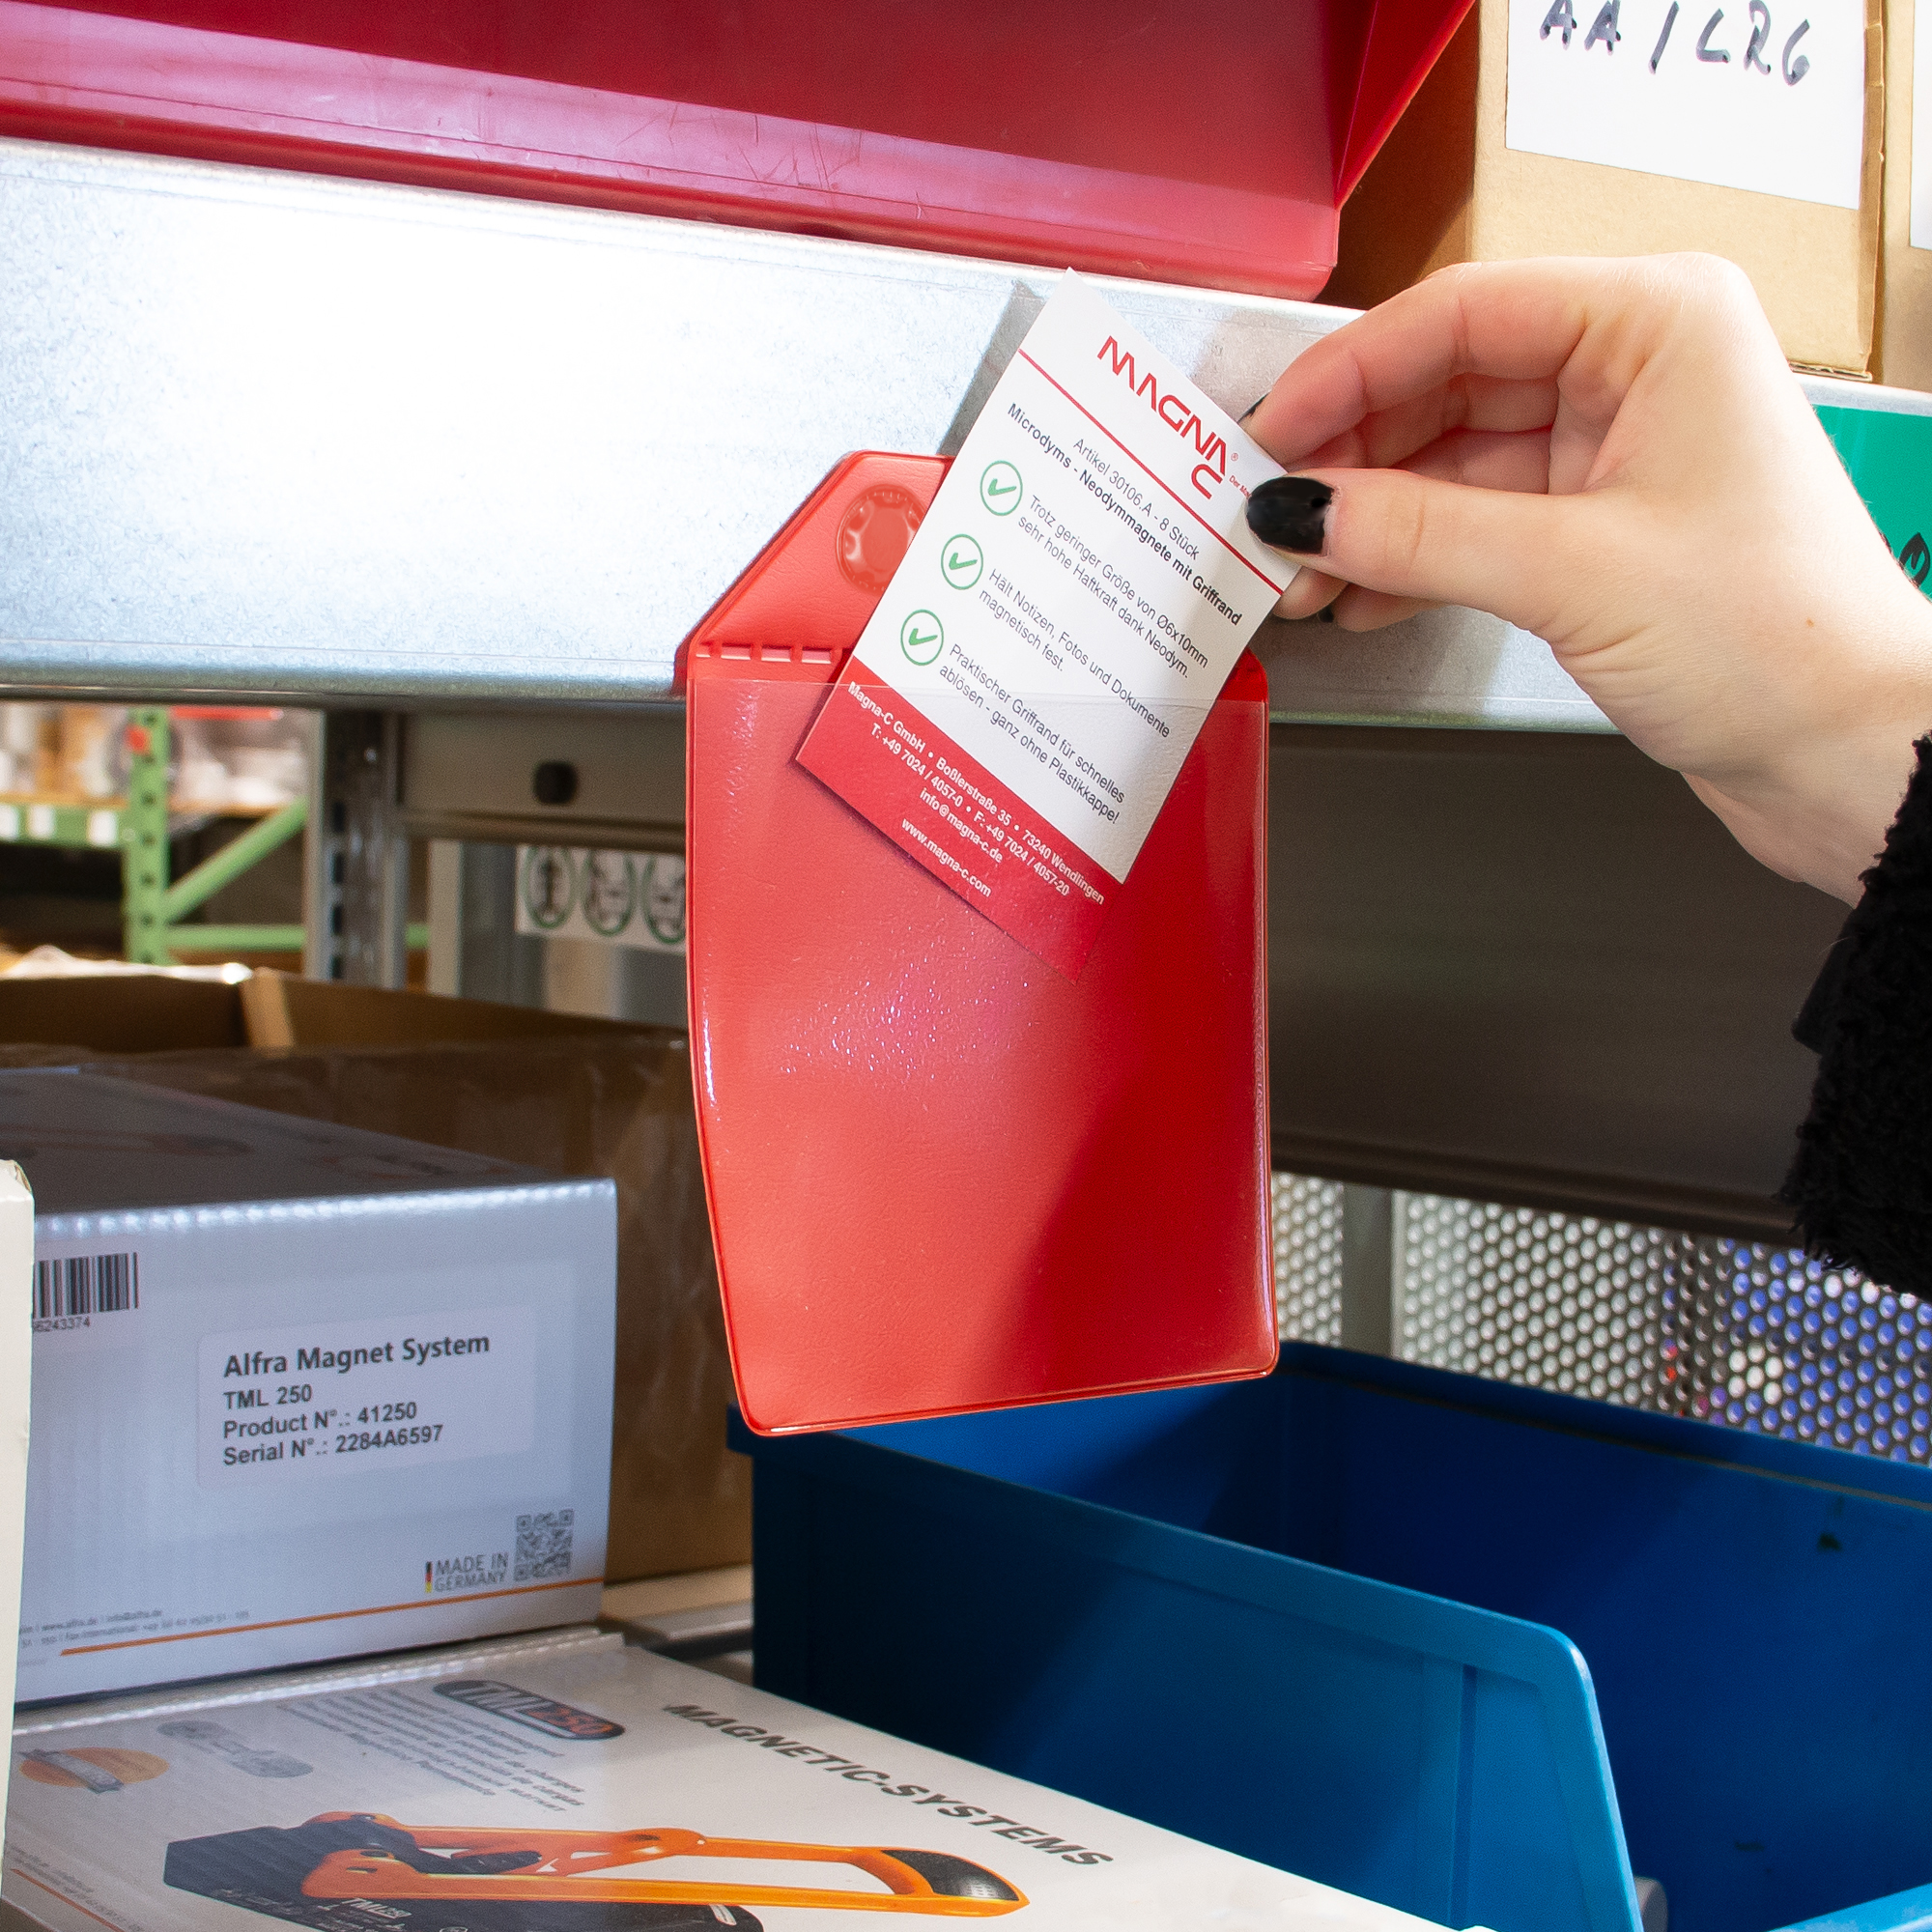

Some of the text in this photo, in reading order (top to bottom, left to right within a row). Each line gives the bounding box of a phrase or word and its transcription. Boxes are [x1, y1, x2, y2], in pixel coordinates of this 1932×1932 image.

[1540, 0, 1621, 55] AA
[1008, 403, 1072, 469] Microdyms
[1079, 469, 1172, 562] Neodymmagnete
[1172, 558, 1193, 582] mit
[1192, 575, 1243, 626] Griffrand
[1072, 439, 1111, 476] Artikel
[1108, 470, 1152, 518] 30106.A
[1159, 517, 1170, 531] 8
[1168, 526, 1200, 561] Stück
[1190, 464, 1223, 499] C
[1017, 516, 1188, 679] sehr hohe Haftkraft dank Neodym.
[1030, 494, 1208, 668] Trotz geringer Größe von Ø6x10mm
[979, 589, 1064, 672] magnetisch fest.
[988, 568, 1170, 738] Hält Notizen, Fotos und Dokumente
[939, 665, 984, 709] ablösen
[989, 710, 1020, 740] ganz
[1020, 735, 1048, 763] ohne
[1048, 756, 1121, 825] Plastikkappe!
[949, 643, 1125, 804] Praktischer Griffrand für schnelles
[847, 680, 1105, 905] Magna-C GmbH Boßlerstraße 35 73240 Wendlingen
[871, 723, 882, 739] T:
[882, 736, 902, 754] +49
[900, 749, 926, 776] 7024
[930, 776, 964, 808] 4057-0
[973, 810, 986, 828] F:
[985, 824, 1005, 842] +49
[1004, 836, 1029, 862] 7024
[1033, 862, 1070, 896] 4057-20
[919, 787, 1003, 864] info@magna-c.de
[901, 818, 991, 897] www.magna-c.com
[223, 1336, 490, 1378] Alfra Magnet System
[223, 1383, 313, 1409] TML 250
[223, 1413, 308, 1438] Product
[357, 1401, 417, 1424] 41250
[223, 1441, 285, 1466] Serial
[334, 1424, 443, 1454] 2284A6597
[436, 1551, 509, 1575] MADE IN
[436, 1572, 505, 1592] GERMANY
[663, 1703, 1114, 1866] MAGNETIC-SYSTEMS
